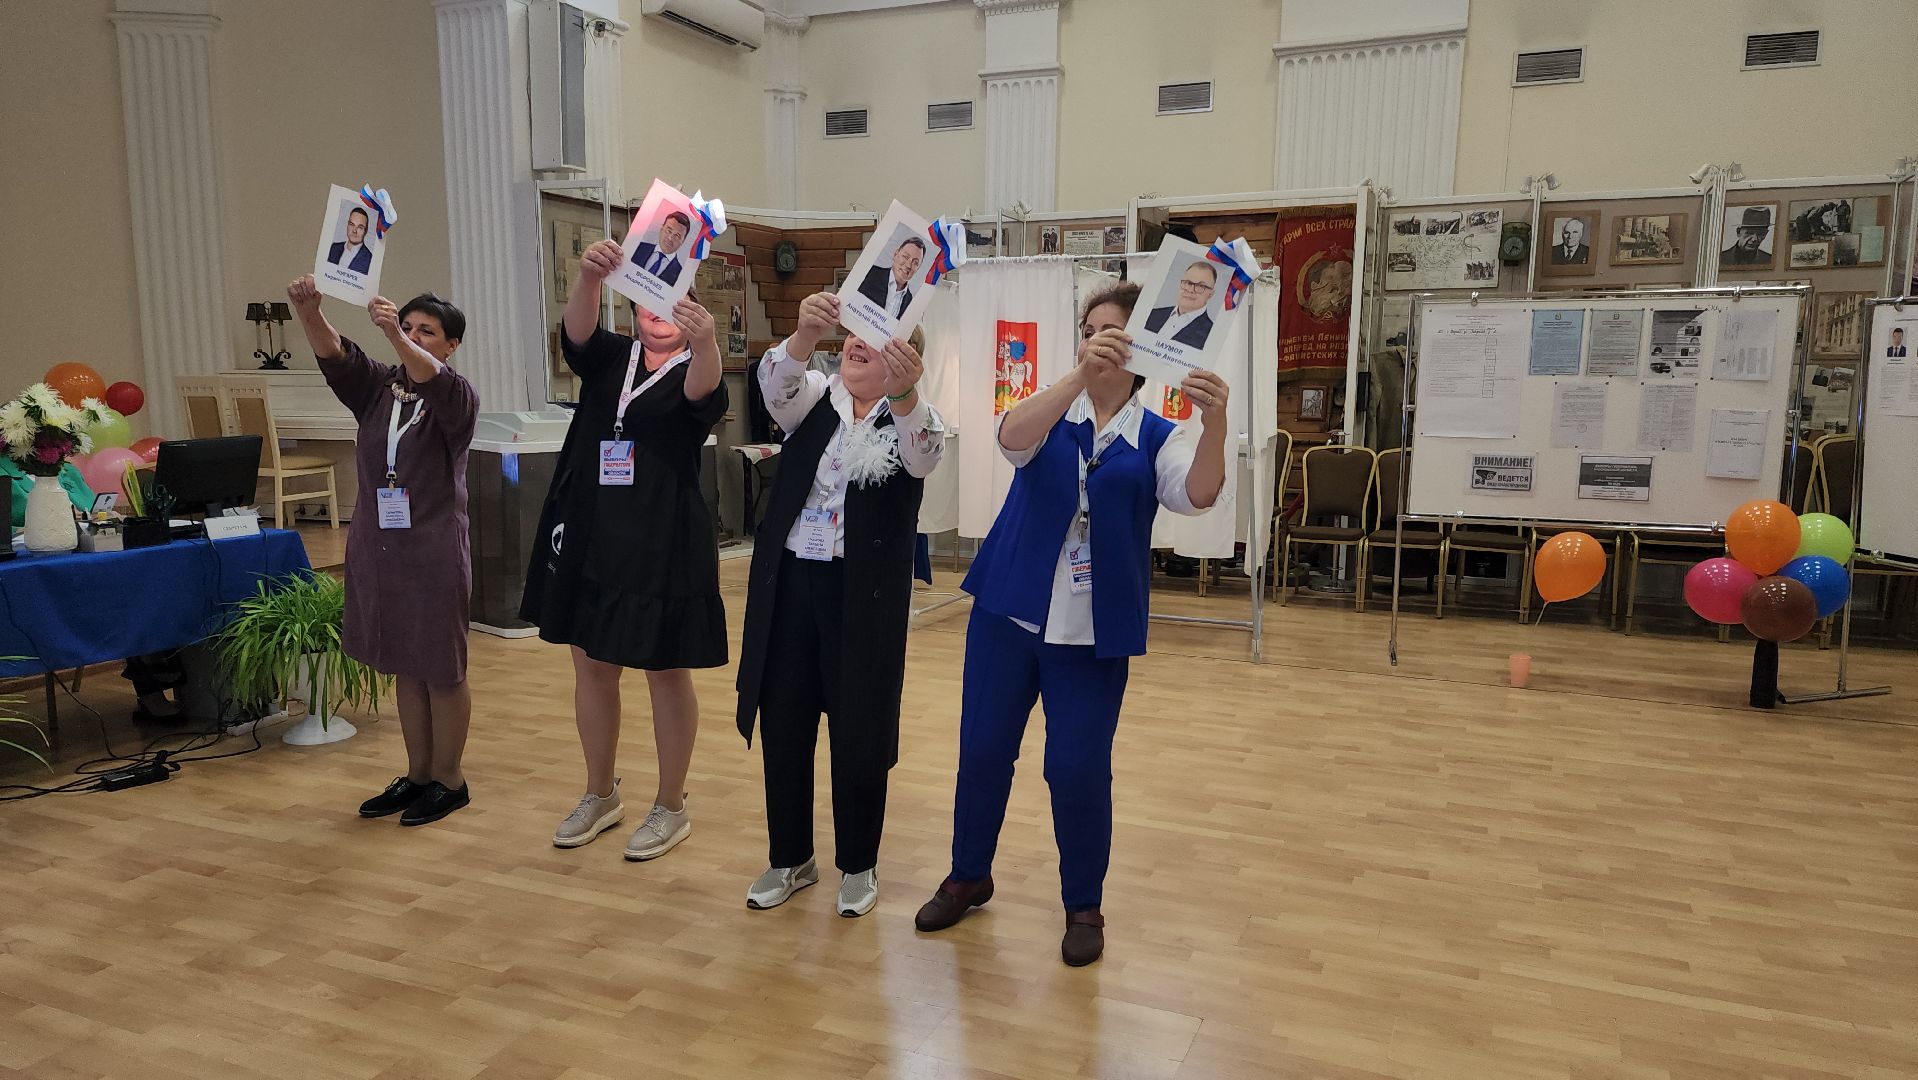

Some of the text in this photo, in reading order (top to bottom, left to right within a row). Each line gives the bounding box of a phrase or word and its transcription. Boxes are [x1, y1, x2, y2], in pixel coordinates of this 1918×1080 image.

[1305, 220, 1326, 234] ВСЕХ
[846, 302, 871, 322] Анатолий
[1316, 341, 1327, 350] НА
[1474, 456, 1533, 468] ВНИМАНИЕ!
[1497, 474, 1529, 483] ВЕДЕТСЯ
